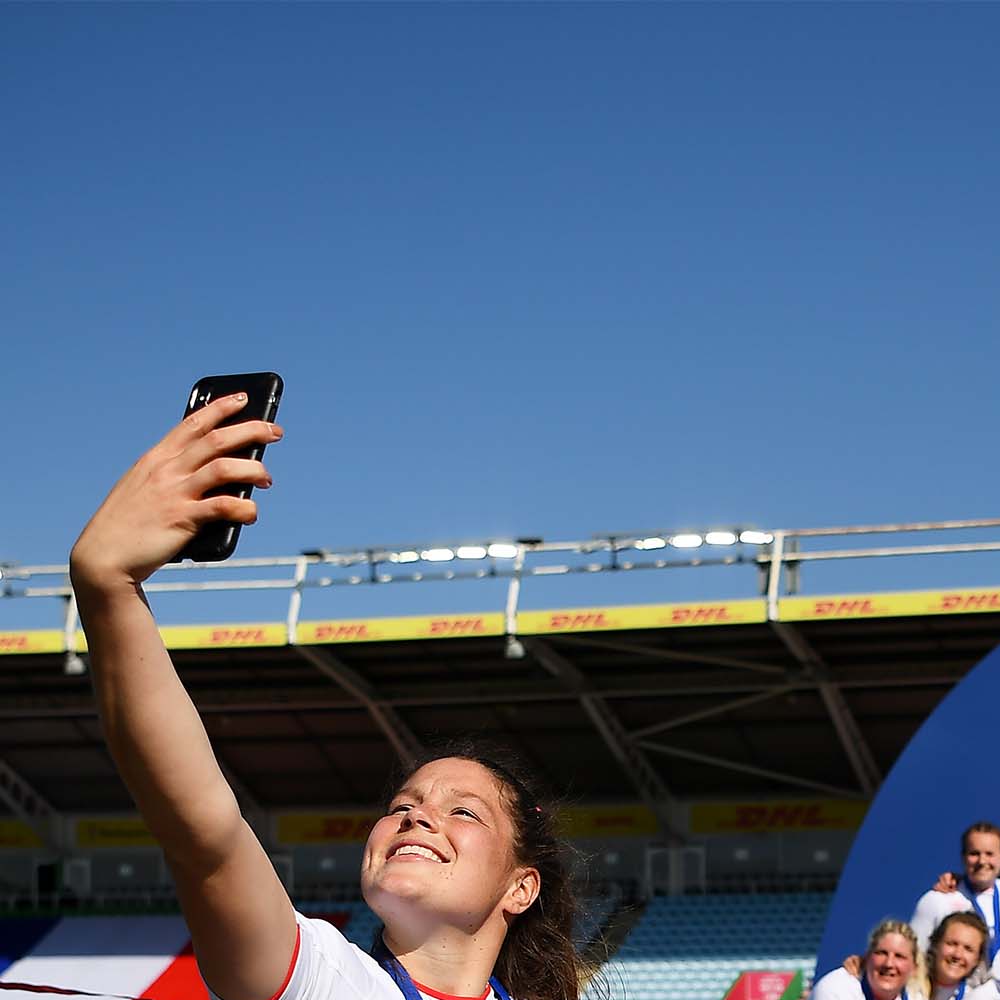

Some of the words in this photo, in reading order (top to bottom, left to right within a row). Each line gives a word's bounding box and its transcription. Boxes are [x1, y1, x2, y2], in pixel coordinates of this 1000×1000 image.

[671, 607, 731, 622] DHL
[814, 600, 876, 615] DHL
[430, 618, 485, 633] DHL
[550, 612, 608, 629] DHL
[211, 630, 266, 643] DHL
[314, 625, 369, 639] DHL
